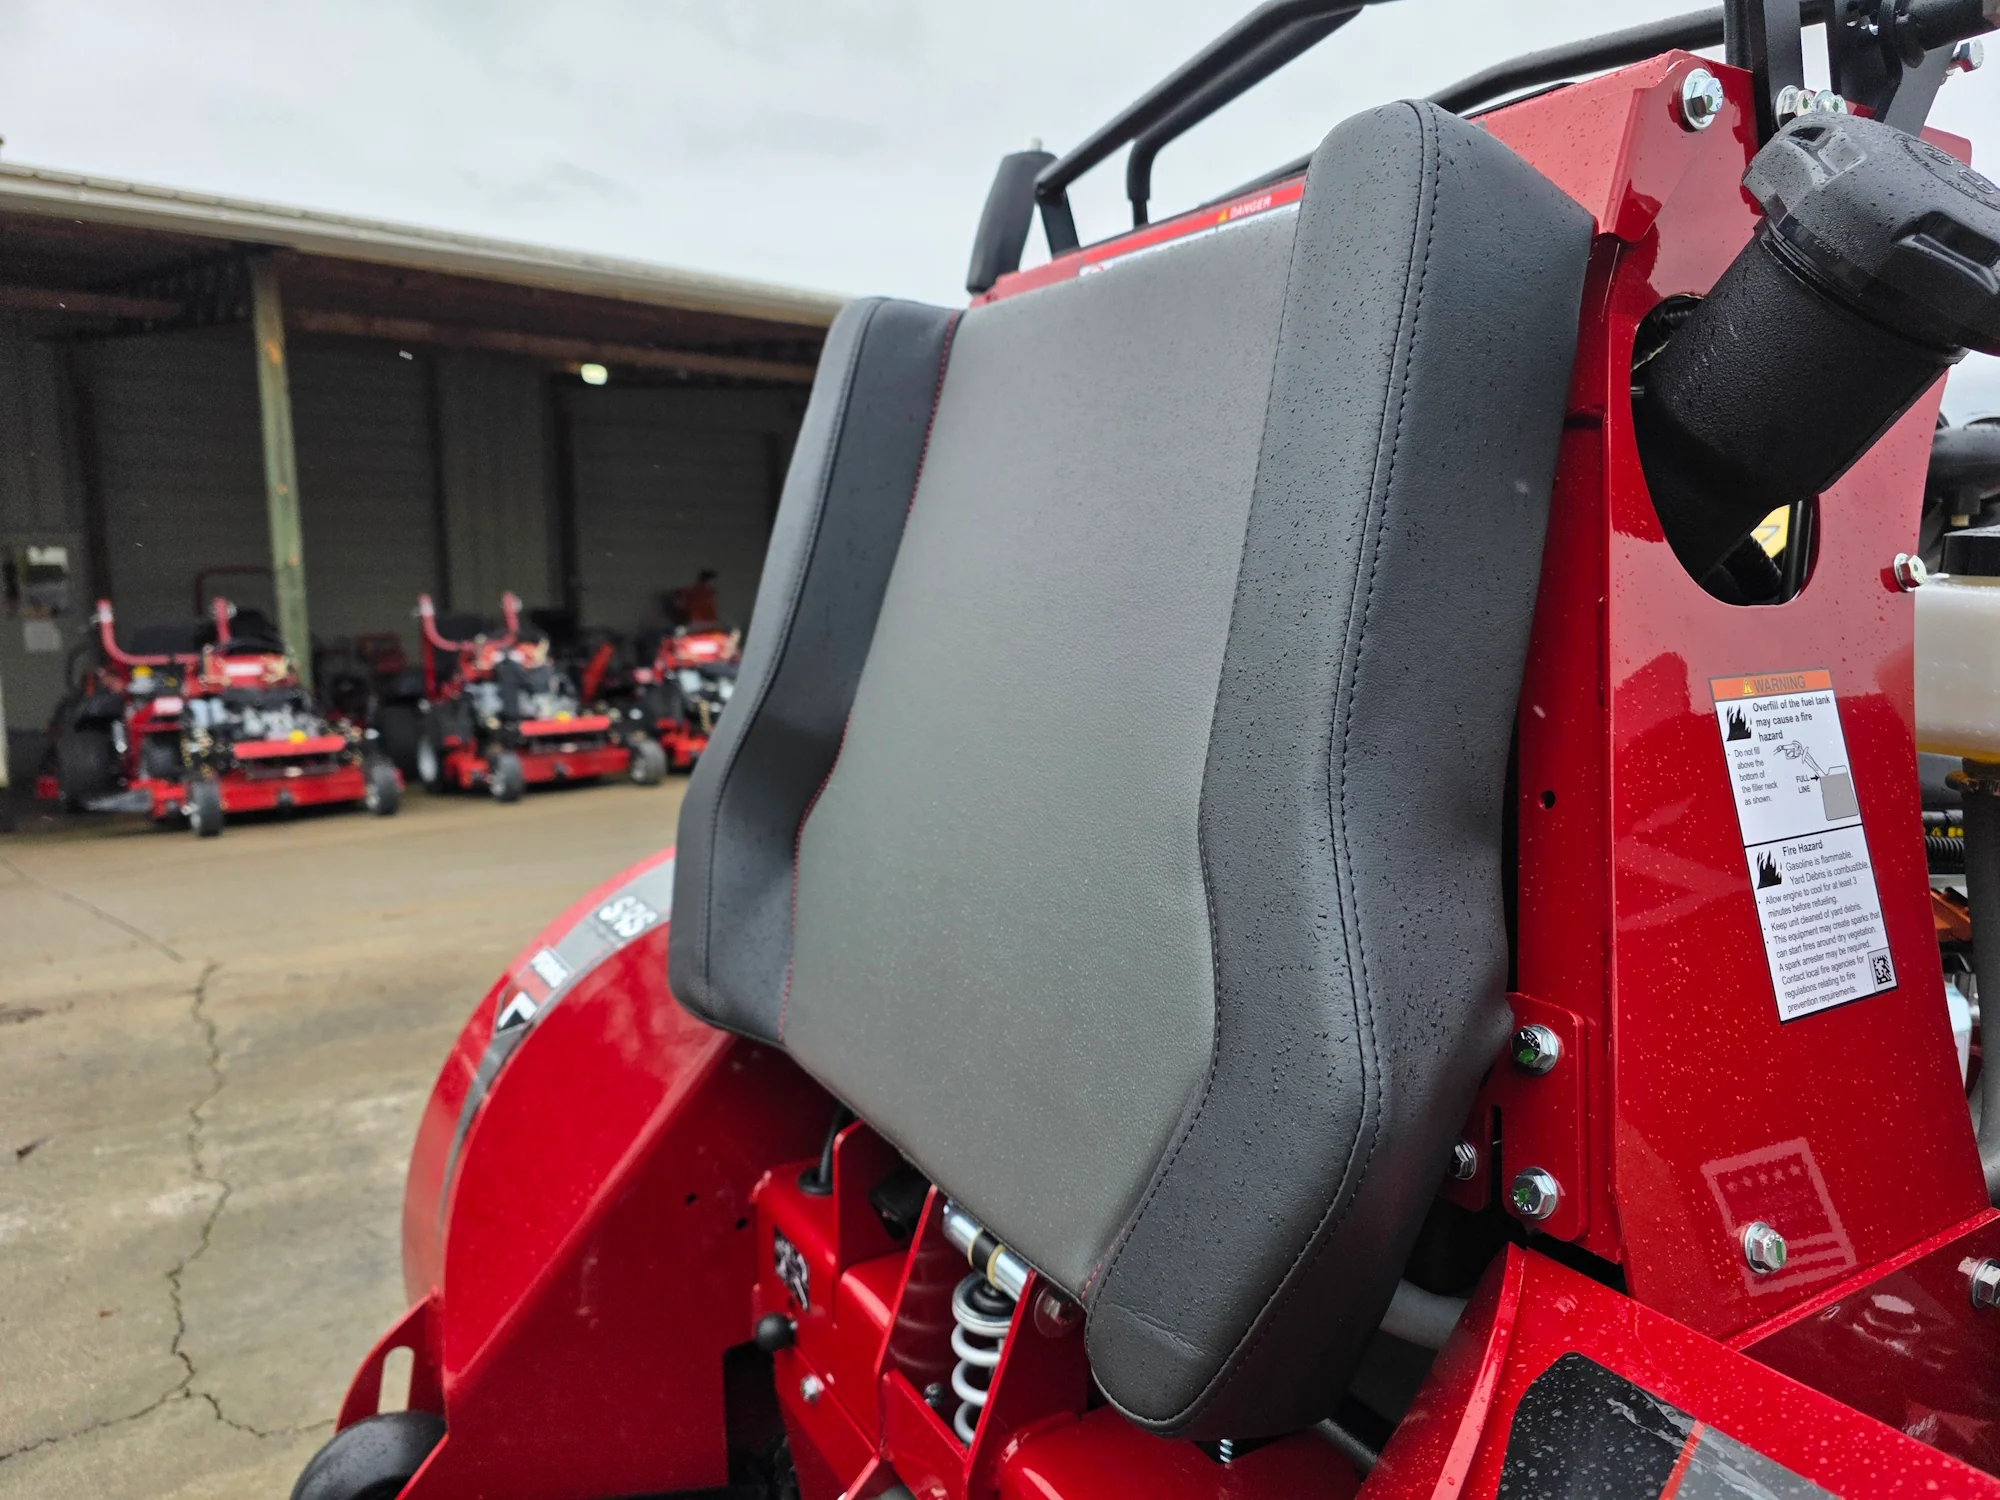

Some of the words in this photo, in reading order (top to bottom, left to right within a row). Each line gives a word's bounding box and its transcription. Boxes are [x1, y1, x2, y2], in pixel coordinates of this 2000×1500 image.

[1229, 195, 1272, 220] DANGER
[1754, 675, 1806, 694] WARNING
[1753, 700, 1779, 712] Overfill
[1780, 699, 1787, 709] of
[1788, 699, 1800, 708] the
[1801, 697, 1814, 706] fuel
[1815, 695, 1830, 705] tank
[1756, 719, 1770, 728] may
[1773, 716, 1794, 725] cause
[1800, 712, 1812, 721] fire
[1758, 730, 1783, 742] hazard
[1734, 749, 1743, 757] Do
[1744, 748, 1753, 756] not
[1737, 762, 1754, 770] above
[1739, 773, 1759, 782] bottom
[1765, 781, 1778, 789] neck
[1796, 775, 1810, 783] FULL
[1798, 785, 1811, 793] LINE
[1753, 796, 1772, 804] shown.
[1782, 846, 1797, 856] Fire
[1798, 839, 1823, 853] Hazard
[1786, 859, 1813, 871] Gasoline
[1814, 857, 1820, 865] is
[1821, 851, 1853, 864] flammable.
[1789, 874, 1805, 885] Yard
[1805, 870, 1826, 882] Debris
[1826, 868, 1833, 877] is
[1834, 861, 1870, 876] combustible.
[1766, 895, 1781, 905] Allow
[1783, 890, 1802, 901] engine
[1803, 888, 1809, 896] to
[1810, 884, 1823, 894] cool
[1823, 883, 1831, 891] for
[1832, 881, 1838, 890] at
[1838, 878, 1853, 887] least
[1852, 876, 1857, 885] 3
[1768, 907, 1792, 918] minutes
[1792, 902, 1811, 912] before
[1812, 896, 1838, 908] refueling.
[1771, 922, 1787, 931] Keep
[1788, 917, 1800, 927] unit
[1800, 911, 1823, 924] cleaned
[1824, 909, 1830, 918] of
[1830, 906, 1843, 919] yard
[1773, 935, 1787, 944] This
[1788, 926, 1819, 942] equipment
[1819, 924, 1831, 933] may
[1832, 919, 1850, 930] create
[1851, 914, 1869, 926] sparks
[1869, 911, 1880, 920] that
[1776, 950, 1788, 958] can
[1788, 944, 1802, 955] start
[1802, 942, 1816, 951] fires
[1816, 935, 1836, 948] around
[1837, 934, 1846, 943] dry
[1779, 963, 1784, 972] A
[1785, 959, 1801, 971] spark
[1802, 954, 1824, 966] arrester
[1825, 950, 1837, 959] may
[1847, 940, 1871, 953] required.
[1782, 972, 1805, 985] Contact
[1805, 967, 1820, 978] local
[1820, 965, 1830, 974] fire
[1831, 958, 1856, 972] agencies
[1856, 956, 1864, 964] for
[1785, 984, 1817, 999] regulations
[1818, 977, 1839, 989] relating
[1846, 972, 1856, 980] fire
[1788, 997, 1818, 1014] prevention
[1819, 986, 1857, 1002] requirements.
